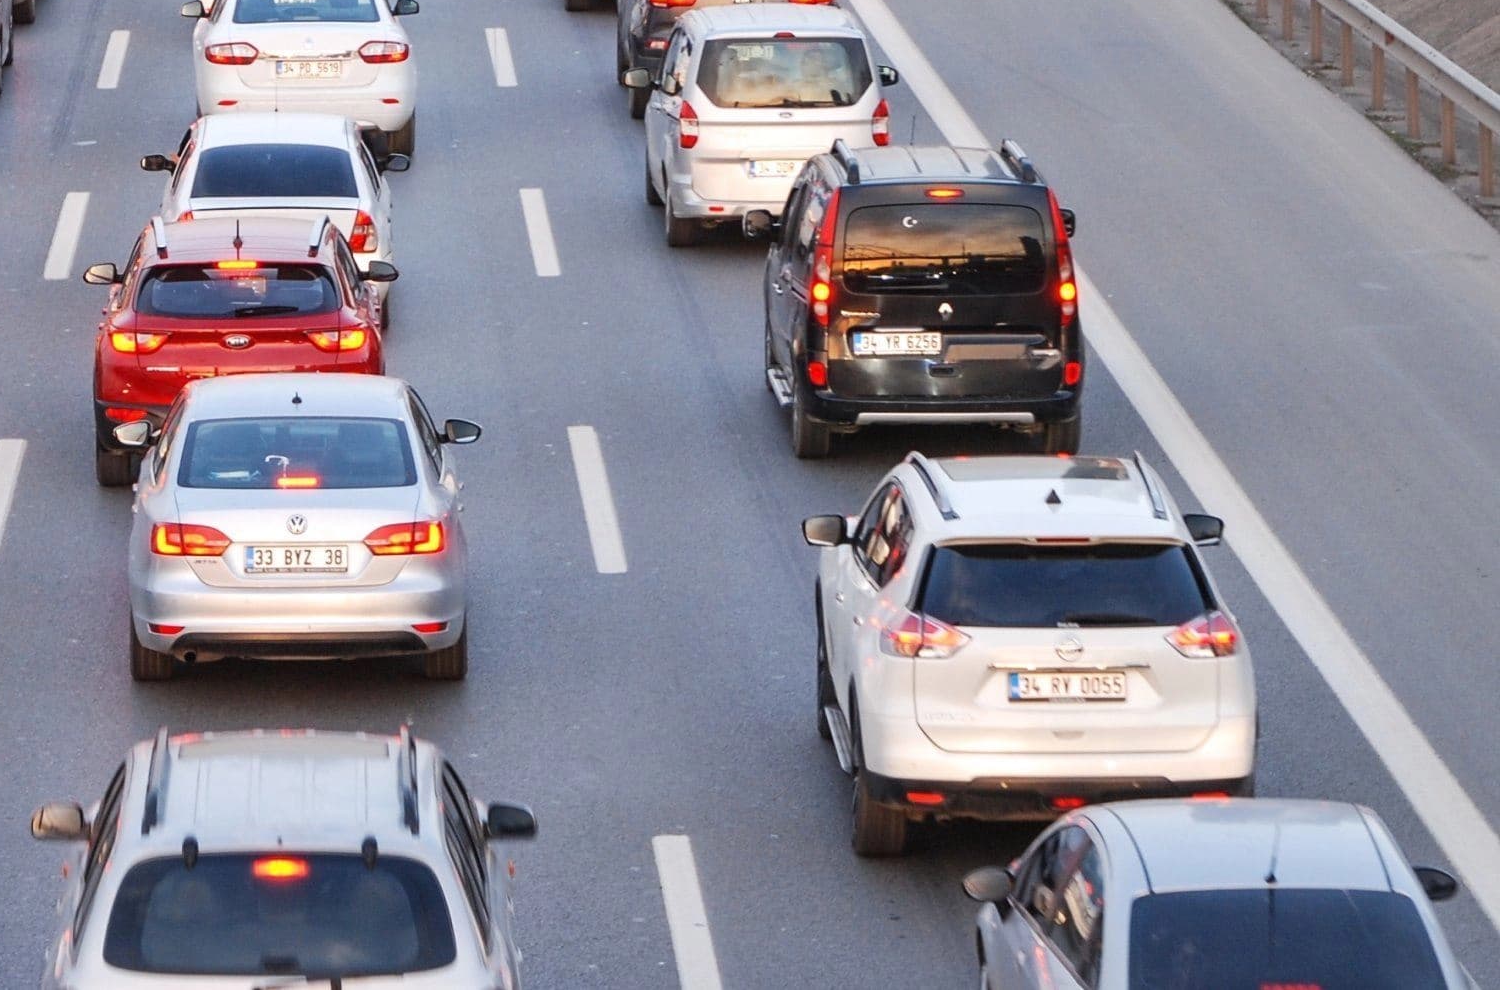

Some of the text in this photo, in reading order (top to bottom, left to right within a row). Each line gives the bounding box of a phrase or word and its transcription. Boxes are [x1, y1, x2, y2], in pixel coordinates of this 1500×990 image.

[862, 336, 938, 349] 34 YR 6256
[255, 549, 343, 565] 33 BYZ 38
[1020, 677, 1041, 694] 34
[1080, 676, 1123, 694] 0055
